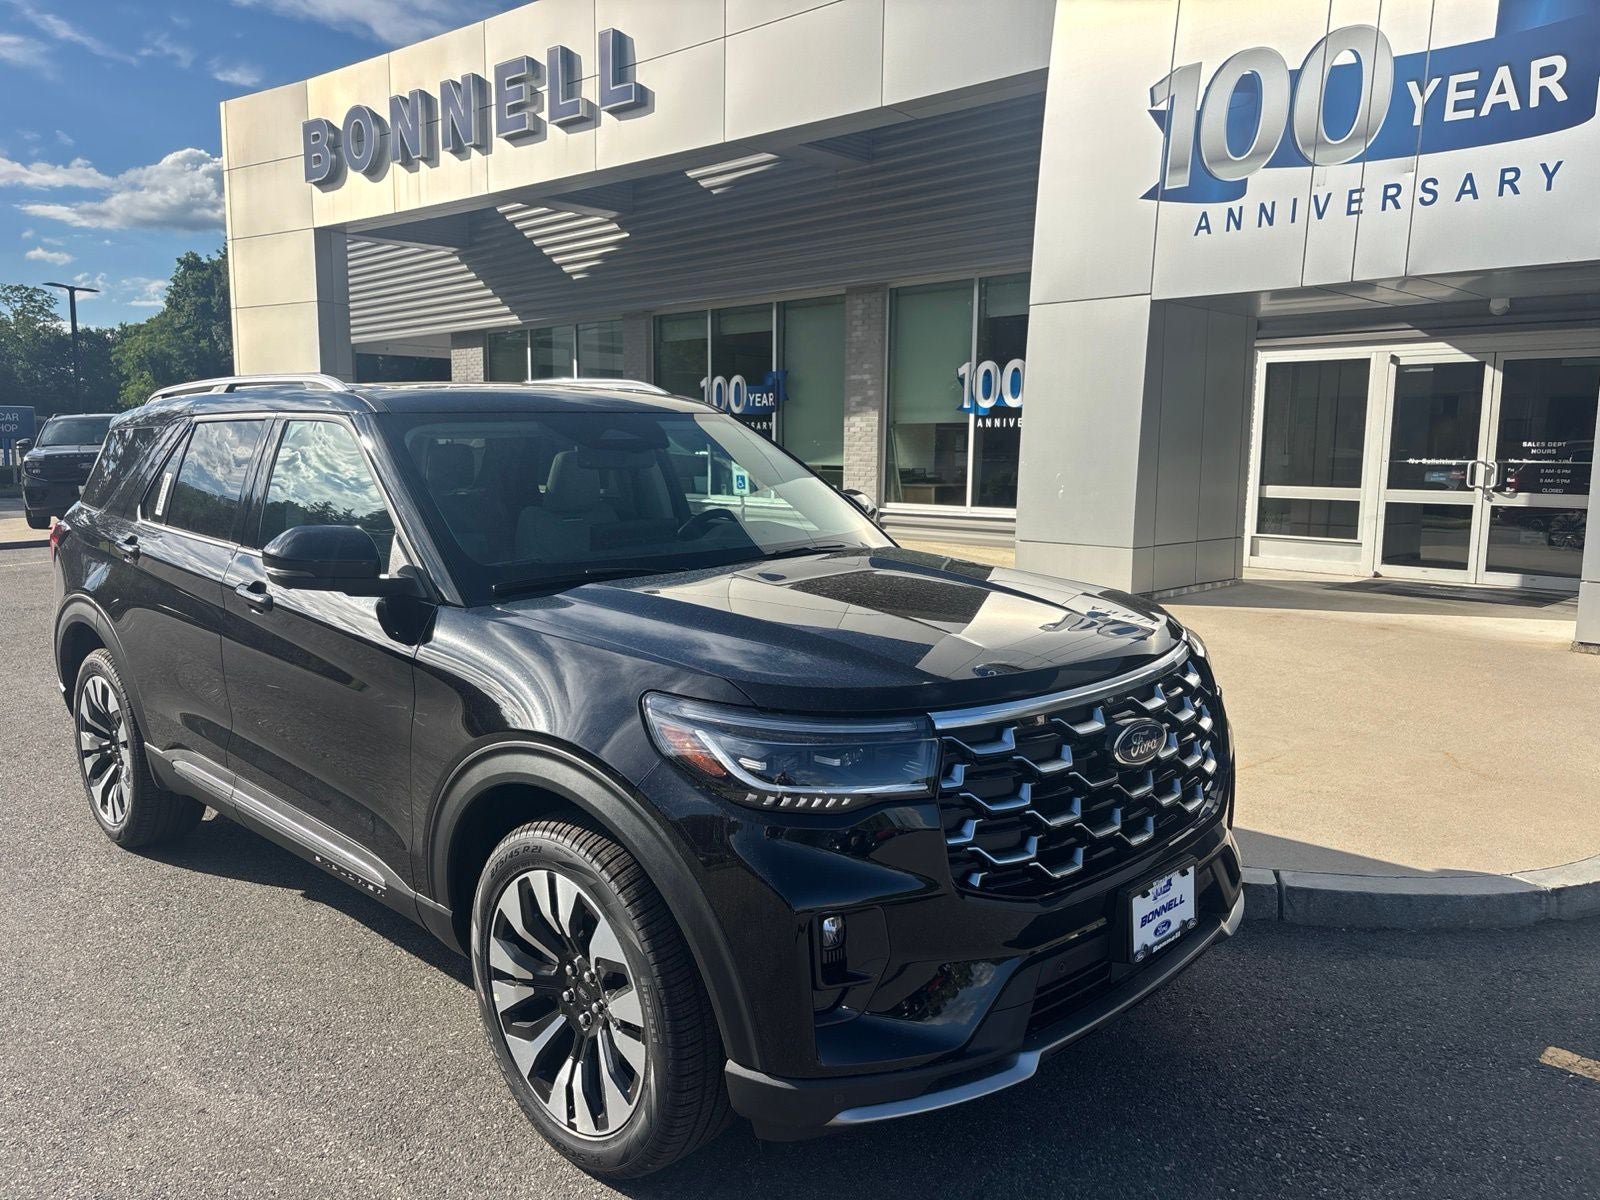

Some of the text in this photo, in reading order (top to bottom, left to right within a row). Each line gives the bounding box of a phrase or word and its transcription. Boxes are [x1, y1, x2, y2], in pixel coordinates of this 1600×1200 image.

[302, 27, 640, 184] BONNELL
[1149, 24, 1569, 190] 100 YEAR
[1194, 160, 1565, 236] ANNIVERSARY
[700, 374, 775, 414] 100 YEAR
[957, 358, 1026, 409] 100
[1131, 730, 1157, 757] Ford
[1140, 894, 1185, 929] BONNELL
